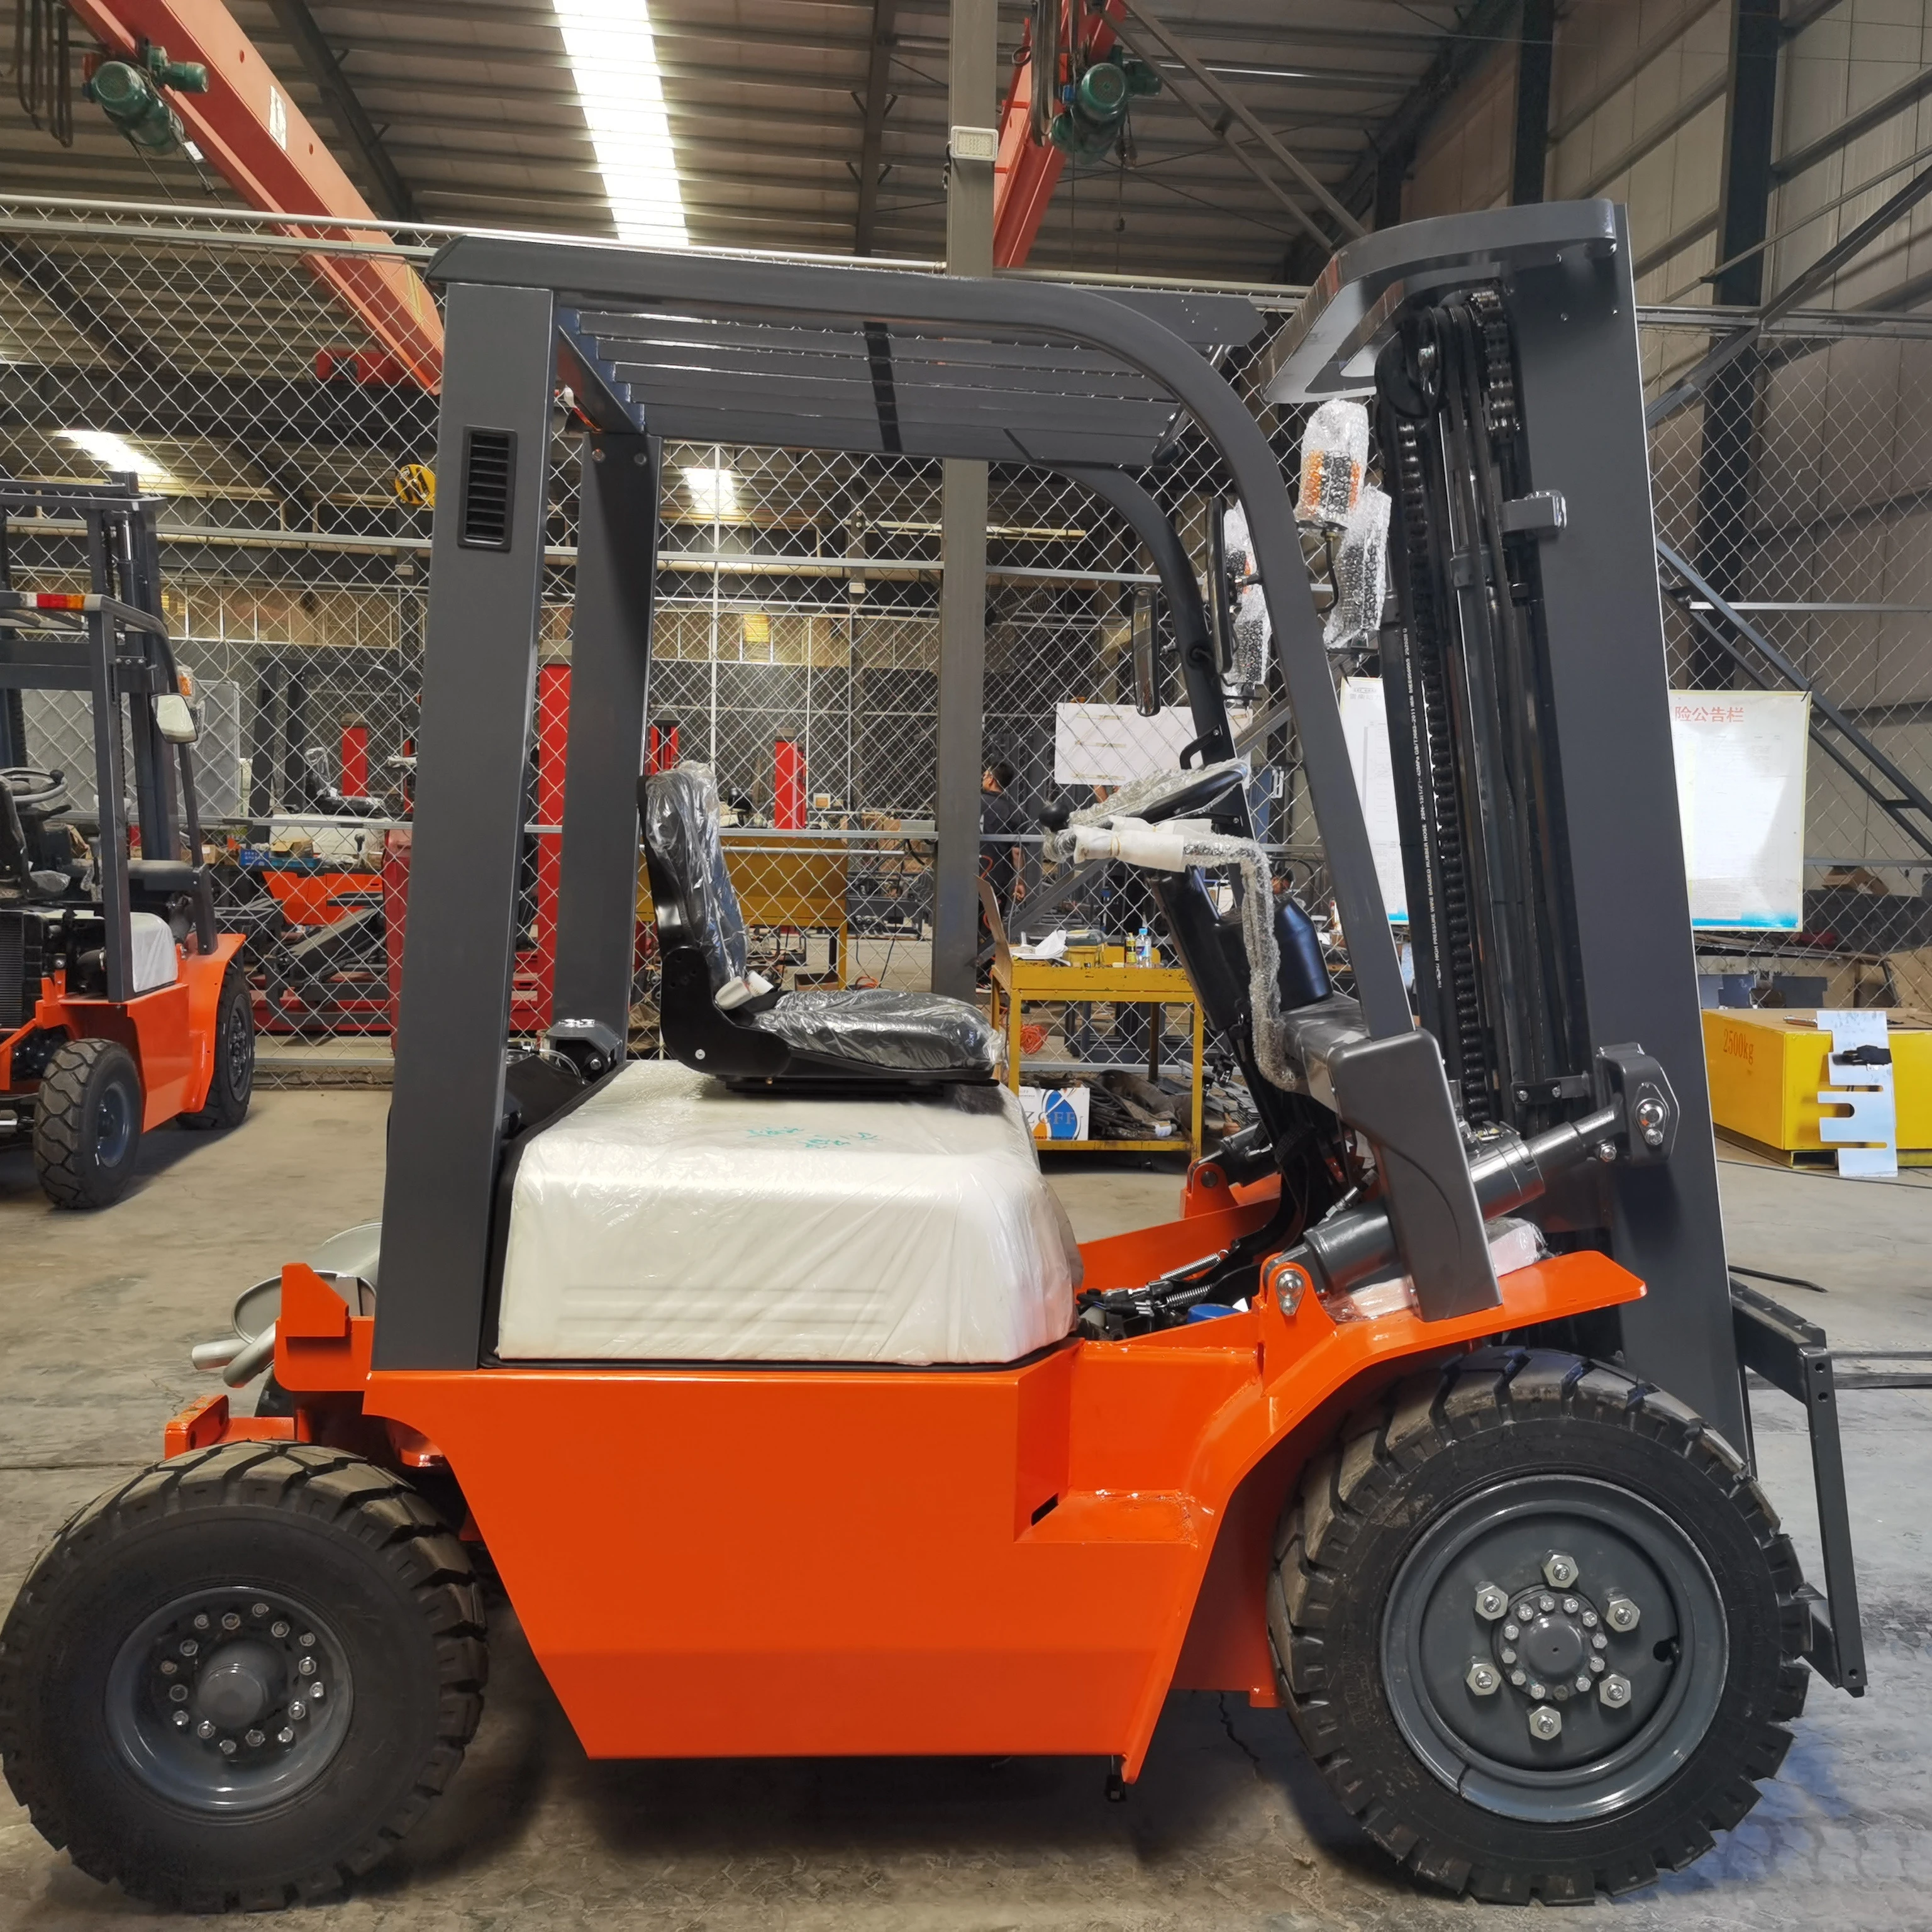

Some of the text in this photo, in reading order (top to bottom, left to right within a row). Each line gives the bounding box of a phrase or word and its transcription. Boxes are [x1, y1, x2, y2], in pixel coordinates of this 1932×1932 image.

[1411, 708, 1419, 755] GB/T3683-2011
[1674, 706, 1744, 723] 险公告栏
[1430, 914, 1438, 945] PRESSURE
[1723, 1028, 1754, 1065] 2500kg
